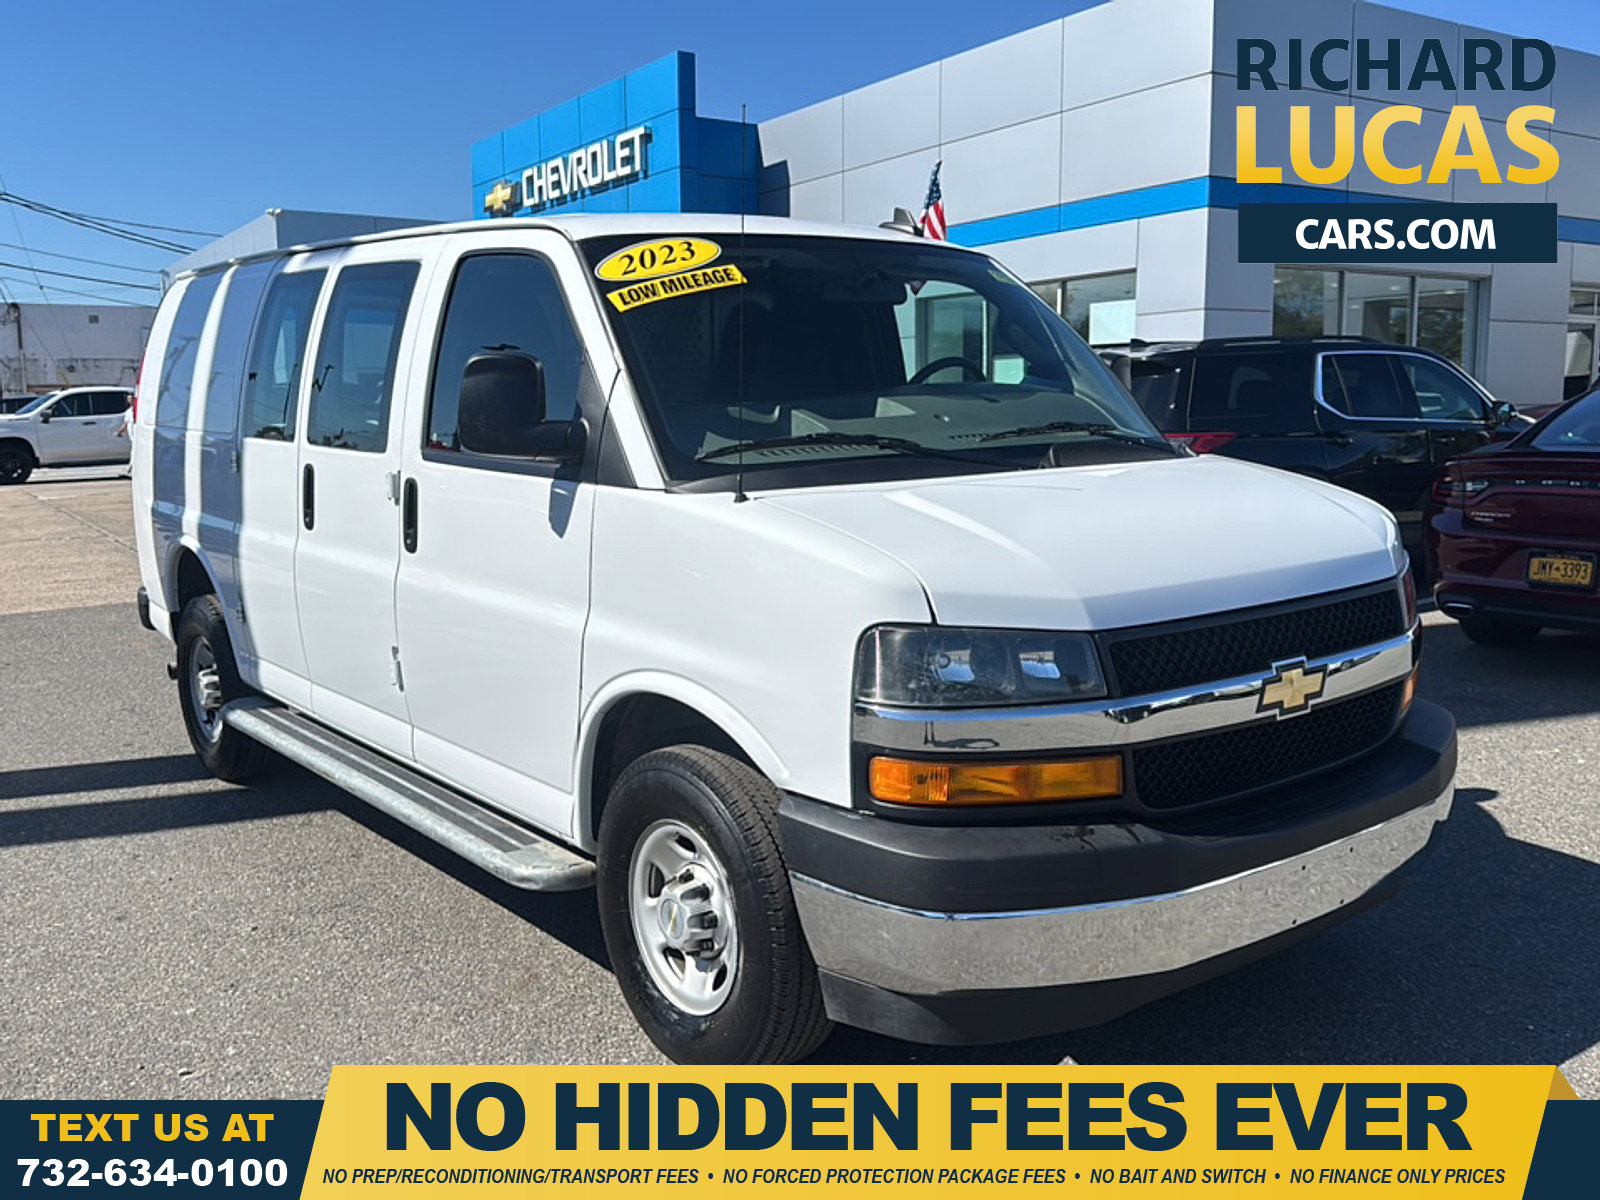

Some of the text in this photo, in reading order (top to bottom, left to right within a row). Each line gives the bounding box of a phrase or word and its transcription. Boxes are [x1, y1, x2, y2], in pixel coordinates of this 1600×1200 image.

[522, 126, 646, 207] CHEVROLET
[620, 241, 696, 276] 2023
[617, 267, 735, 306] LOW MILEAGE
